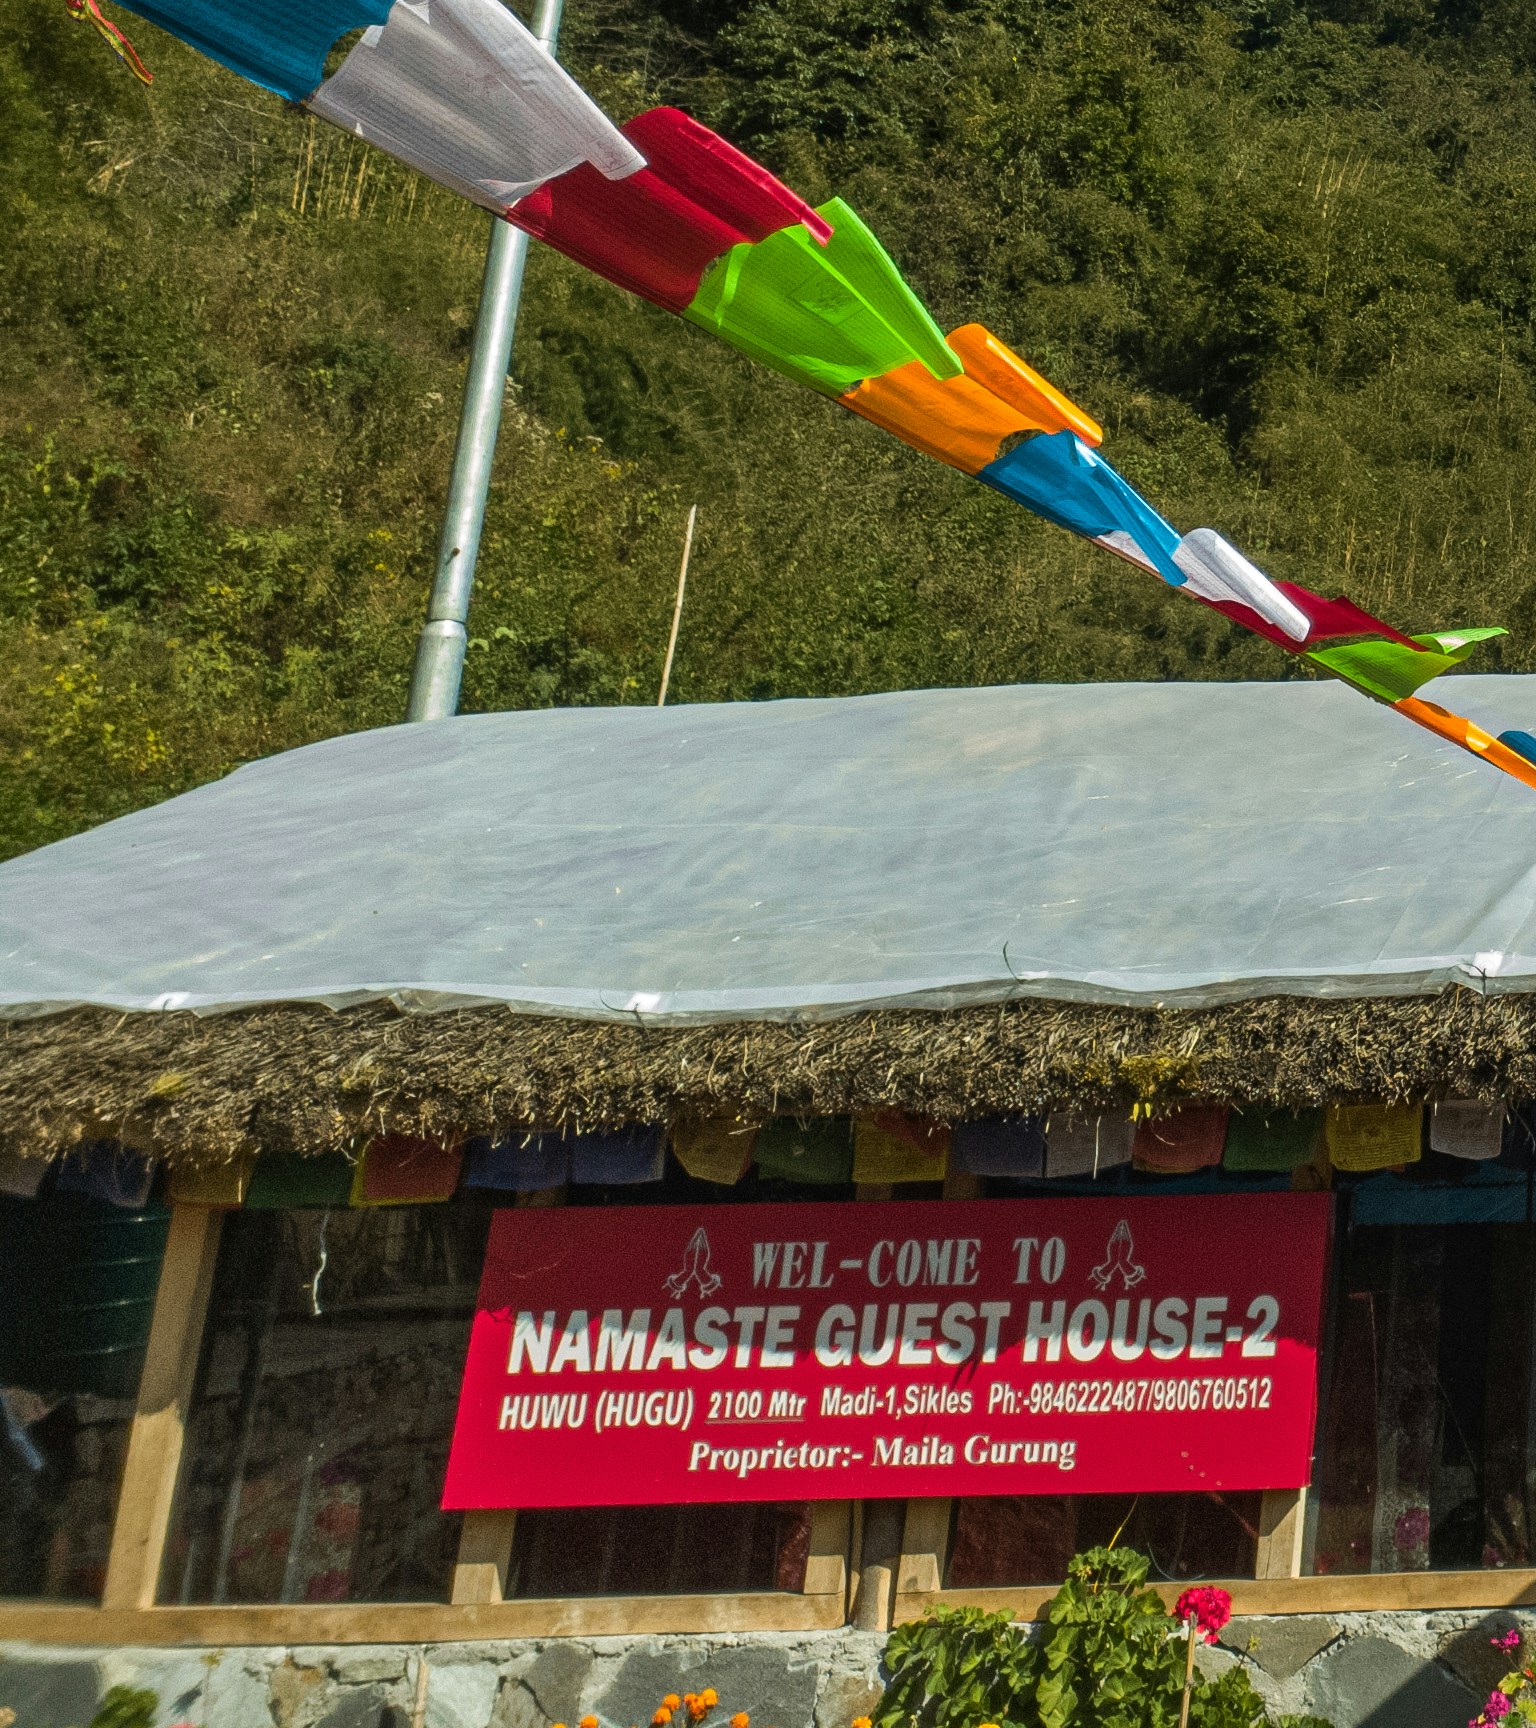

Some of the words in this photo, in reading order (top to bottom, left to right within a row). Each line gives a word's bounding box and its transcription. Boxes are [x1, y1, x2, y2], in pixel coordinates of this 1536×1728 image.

[752, 1238, 981, 1289] WEL-COME
[1012, 1237, 1066, 1285] TO
[507, 1305, 800, 1374] NAMASTE
[814, 1301, 1011, 1368] GUEST
[1022, 1294, 1280, 1363] HOUSE-2
[498, 1393, 588, 1430] HUWU
[595, 1388, 693, 1433] (HUGU)
[707, 1391, 762, 1419] 2100
[767, 1389, 807, 1418] Mtr
[820, 1385, 973, 1420] Madi-1,Sikles
[988, 1377, 1273, 1415] Ph:-9846222487/9806760512
[687, 1439, 863, 1479] Proprietor:-
[871, 1437, 955, 1468] Maila
[964, 1434, 1077, 1471] Gurung
